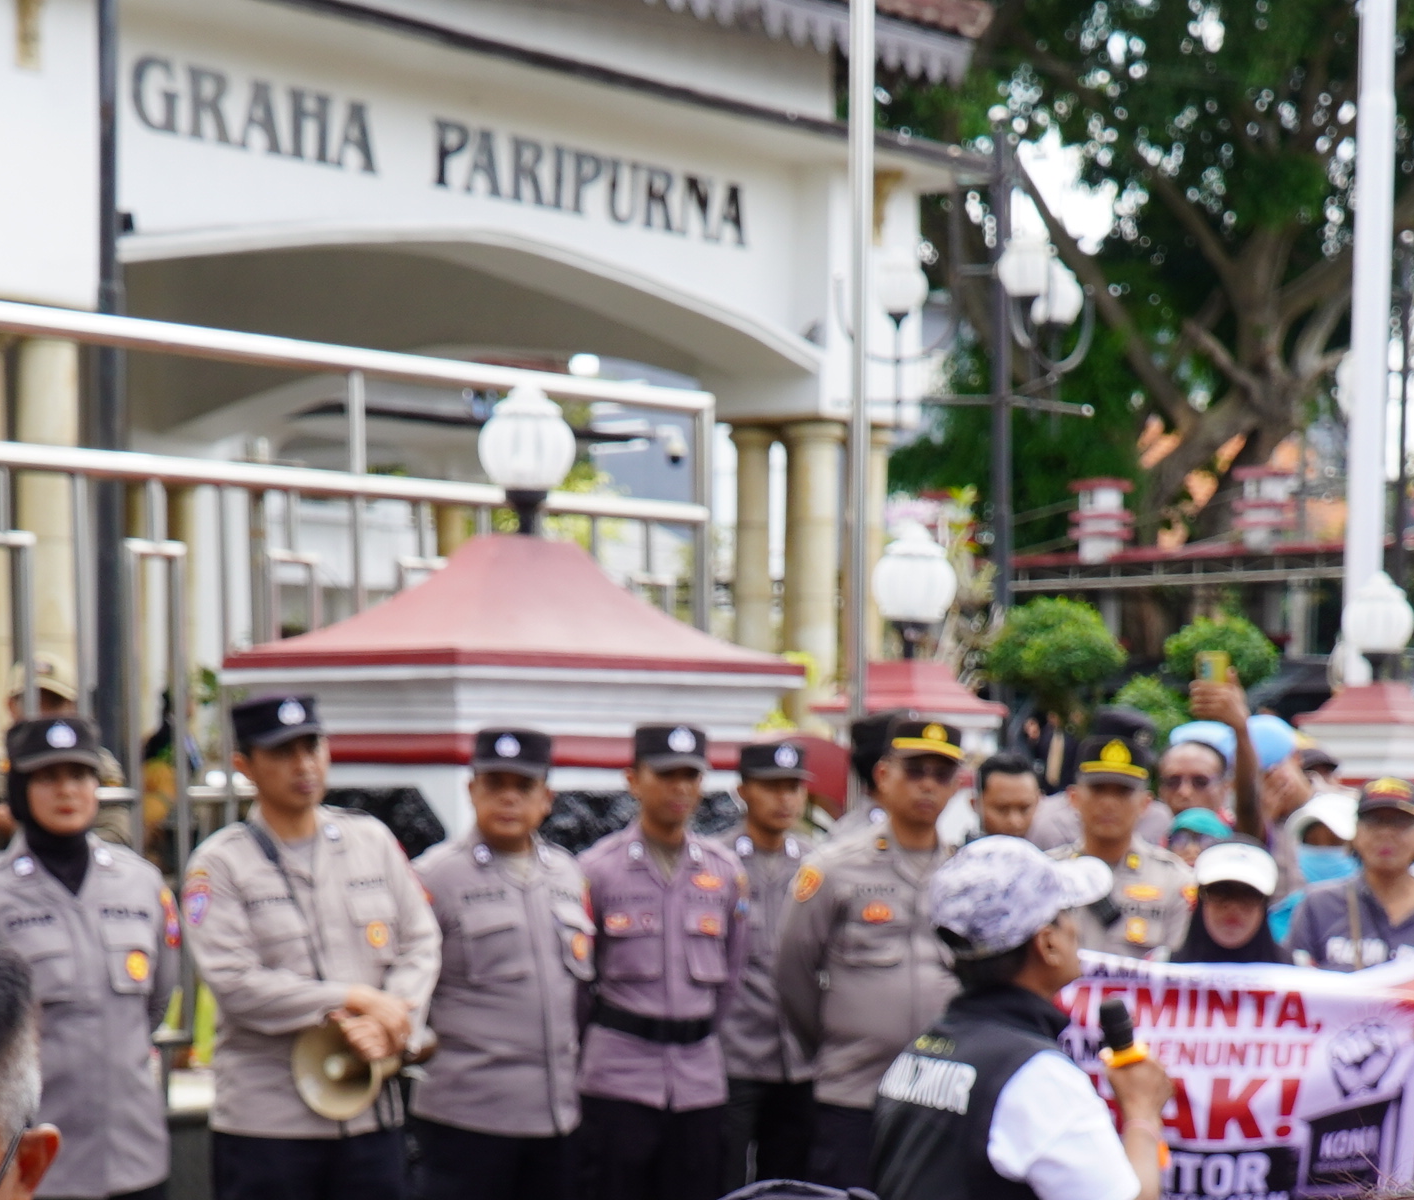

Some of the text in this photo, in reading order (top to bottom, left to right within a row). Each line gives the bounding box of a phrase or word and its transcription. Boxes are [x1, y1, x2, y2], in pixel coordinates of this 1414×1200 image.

[130, 54, 749, 248] GRAHA PARIPURNA
[1149, 1041, 1311, 1068] ENUNTUT
